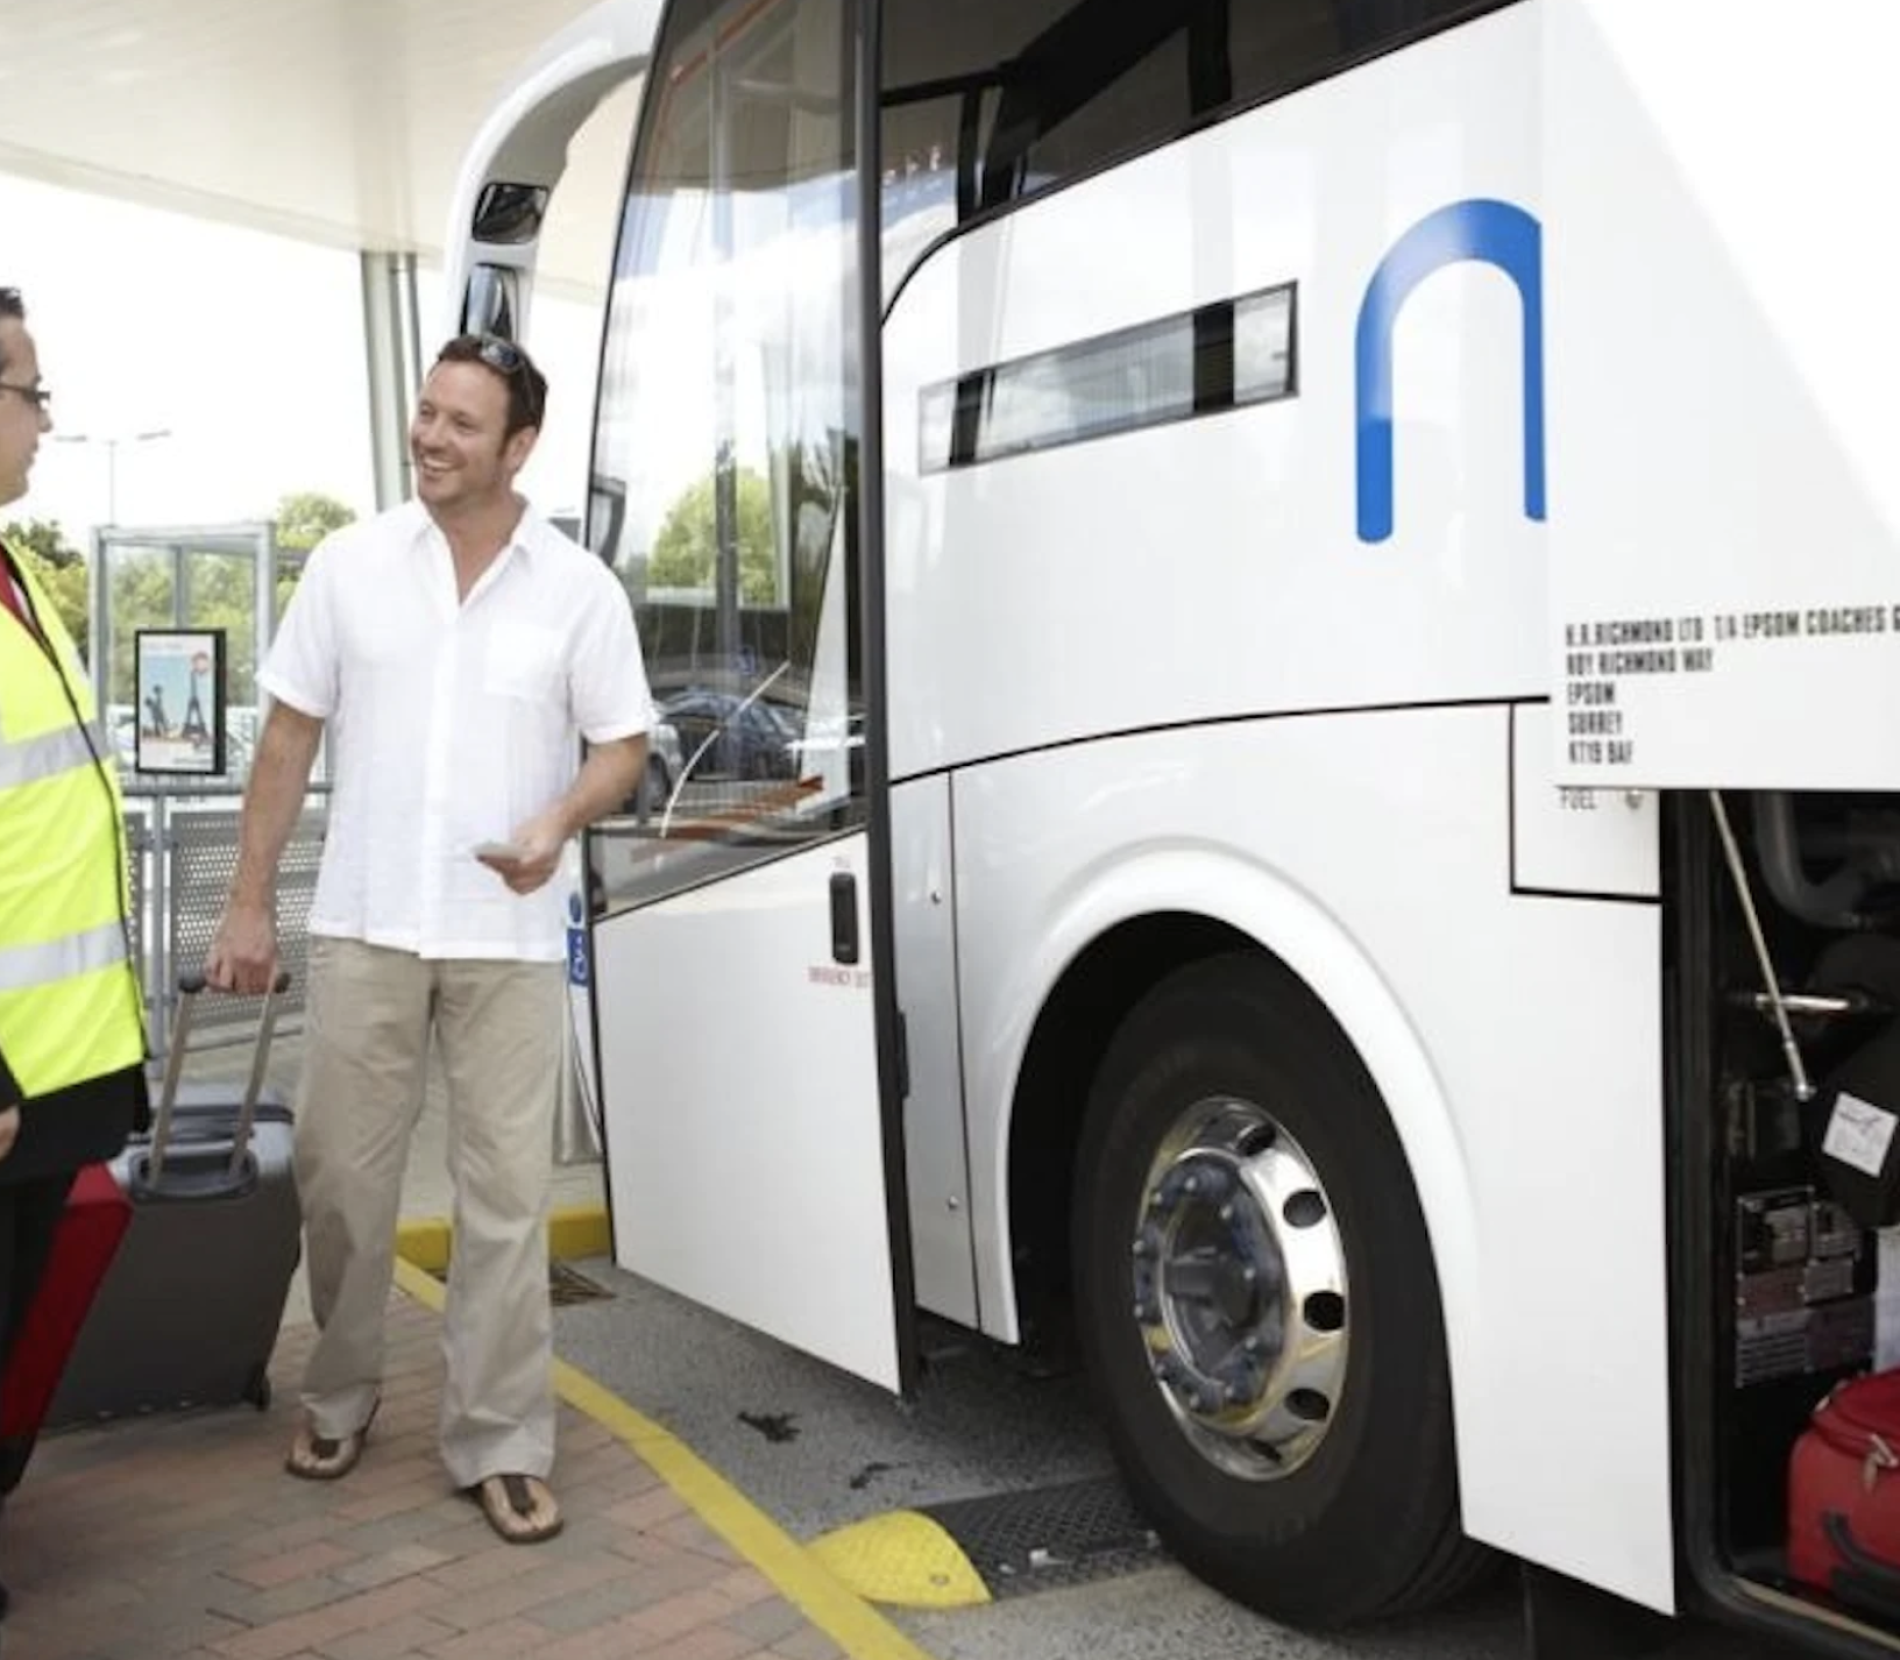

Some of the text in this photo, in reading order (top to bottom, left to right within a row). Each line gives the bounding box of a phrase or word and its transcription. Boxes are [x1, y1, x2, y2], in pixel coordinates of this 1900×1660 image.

[1679, 616, 1703, 642] LTD
[1743, 611, 1799, 639] EPSOM
[1807, 606, 1885, 635] COACHES
[1599, 649, 1676, 675] RICHMOND
[1683, 648, 1713, 673] WAY
[1567, 681, 1615, 705] EPSOM
[1568, 711, 1622, 735] SURREY
[1560, 789, 1596, 810] FUEL
